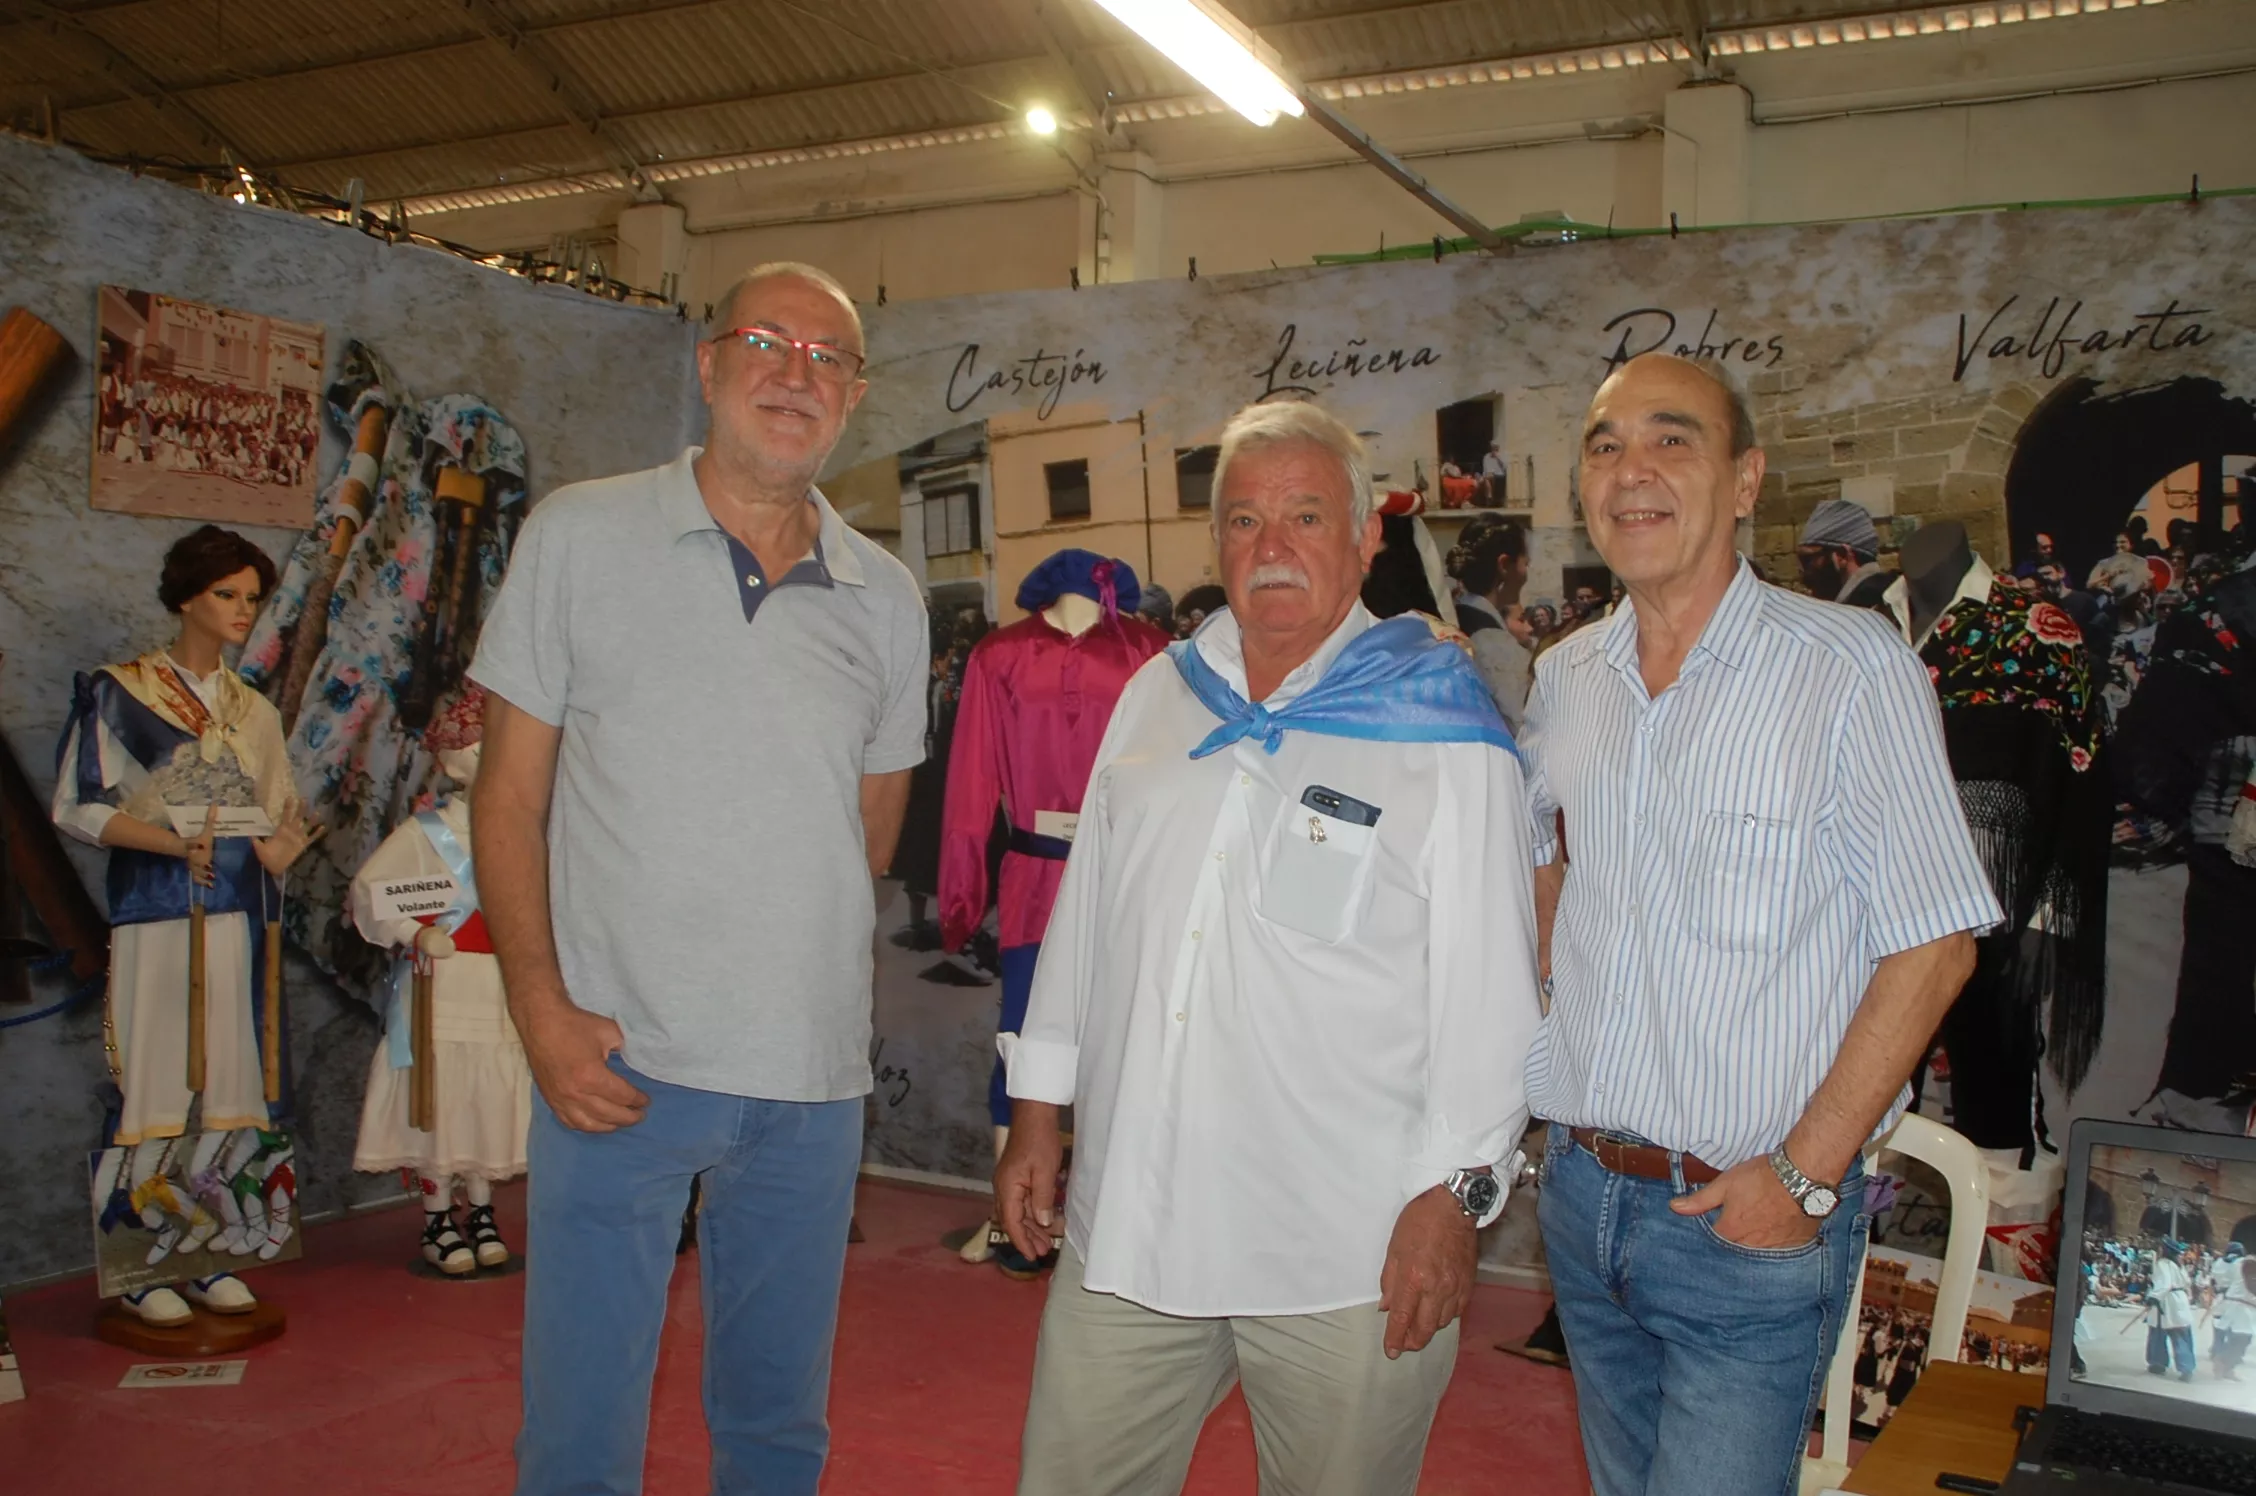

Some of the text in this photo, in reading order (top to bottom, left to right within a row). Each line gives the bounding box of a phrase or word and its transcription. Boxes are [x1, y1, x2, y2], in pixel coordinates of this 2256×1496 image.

[1253, 323, 1442, 404] Leciñena
[1601, 307, 1785, 383] Robres
[1953, 294, 2215, 382] Valfarta
[946, 343, 1109, 421] Castejón
[385, 880, 454, 896] SARIÑENA
[397, 900, 446, 913] Volante
